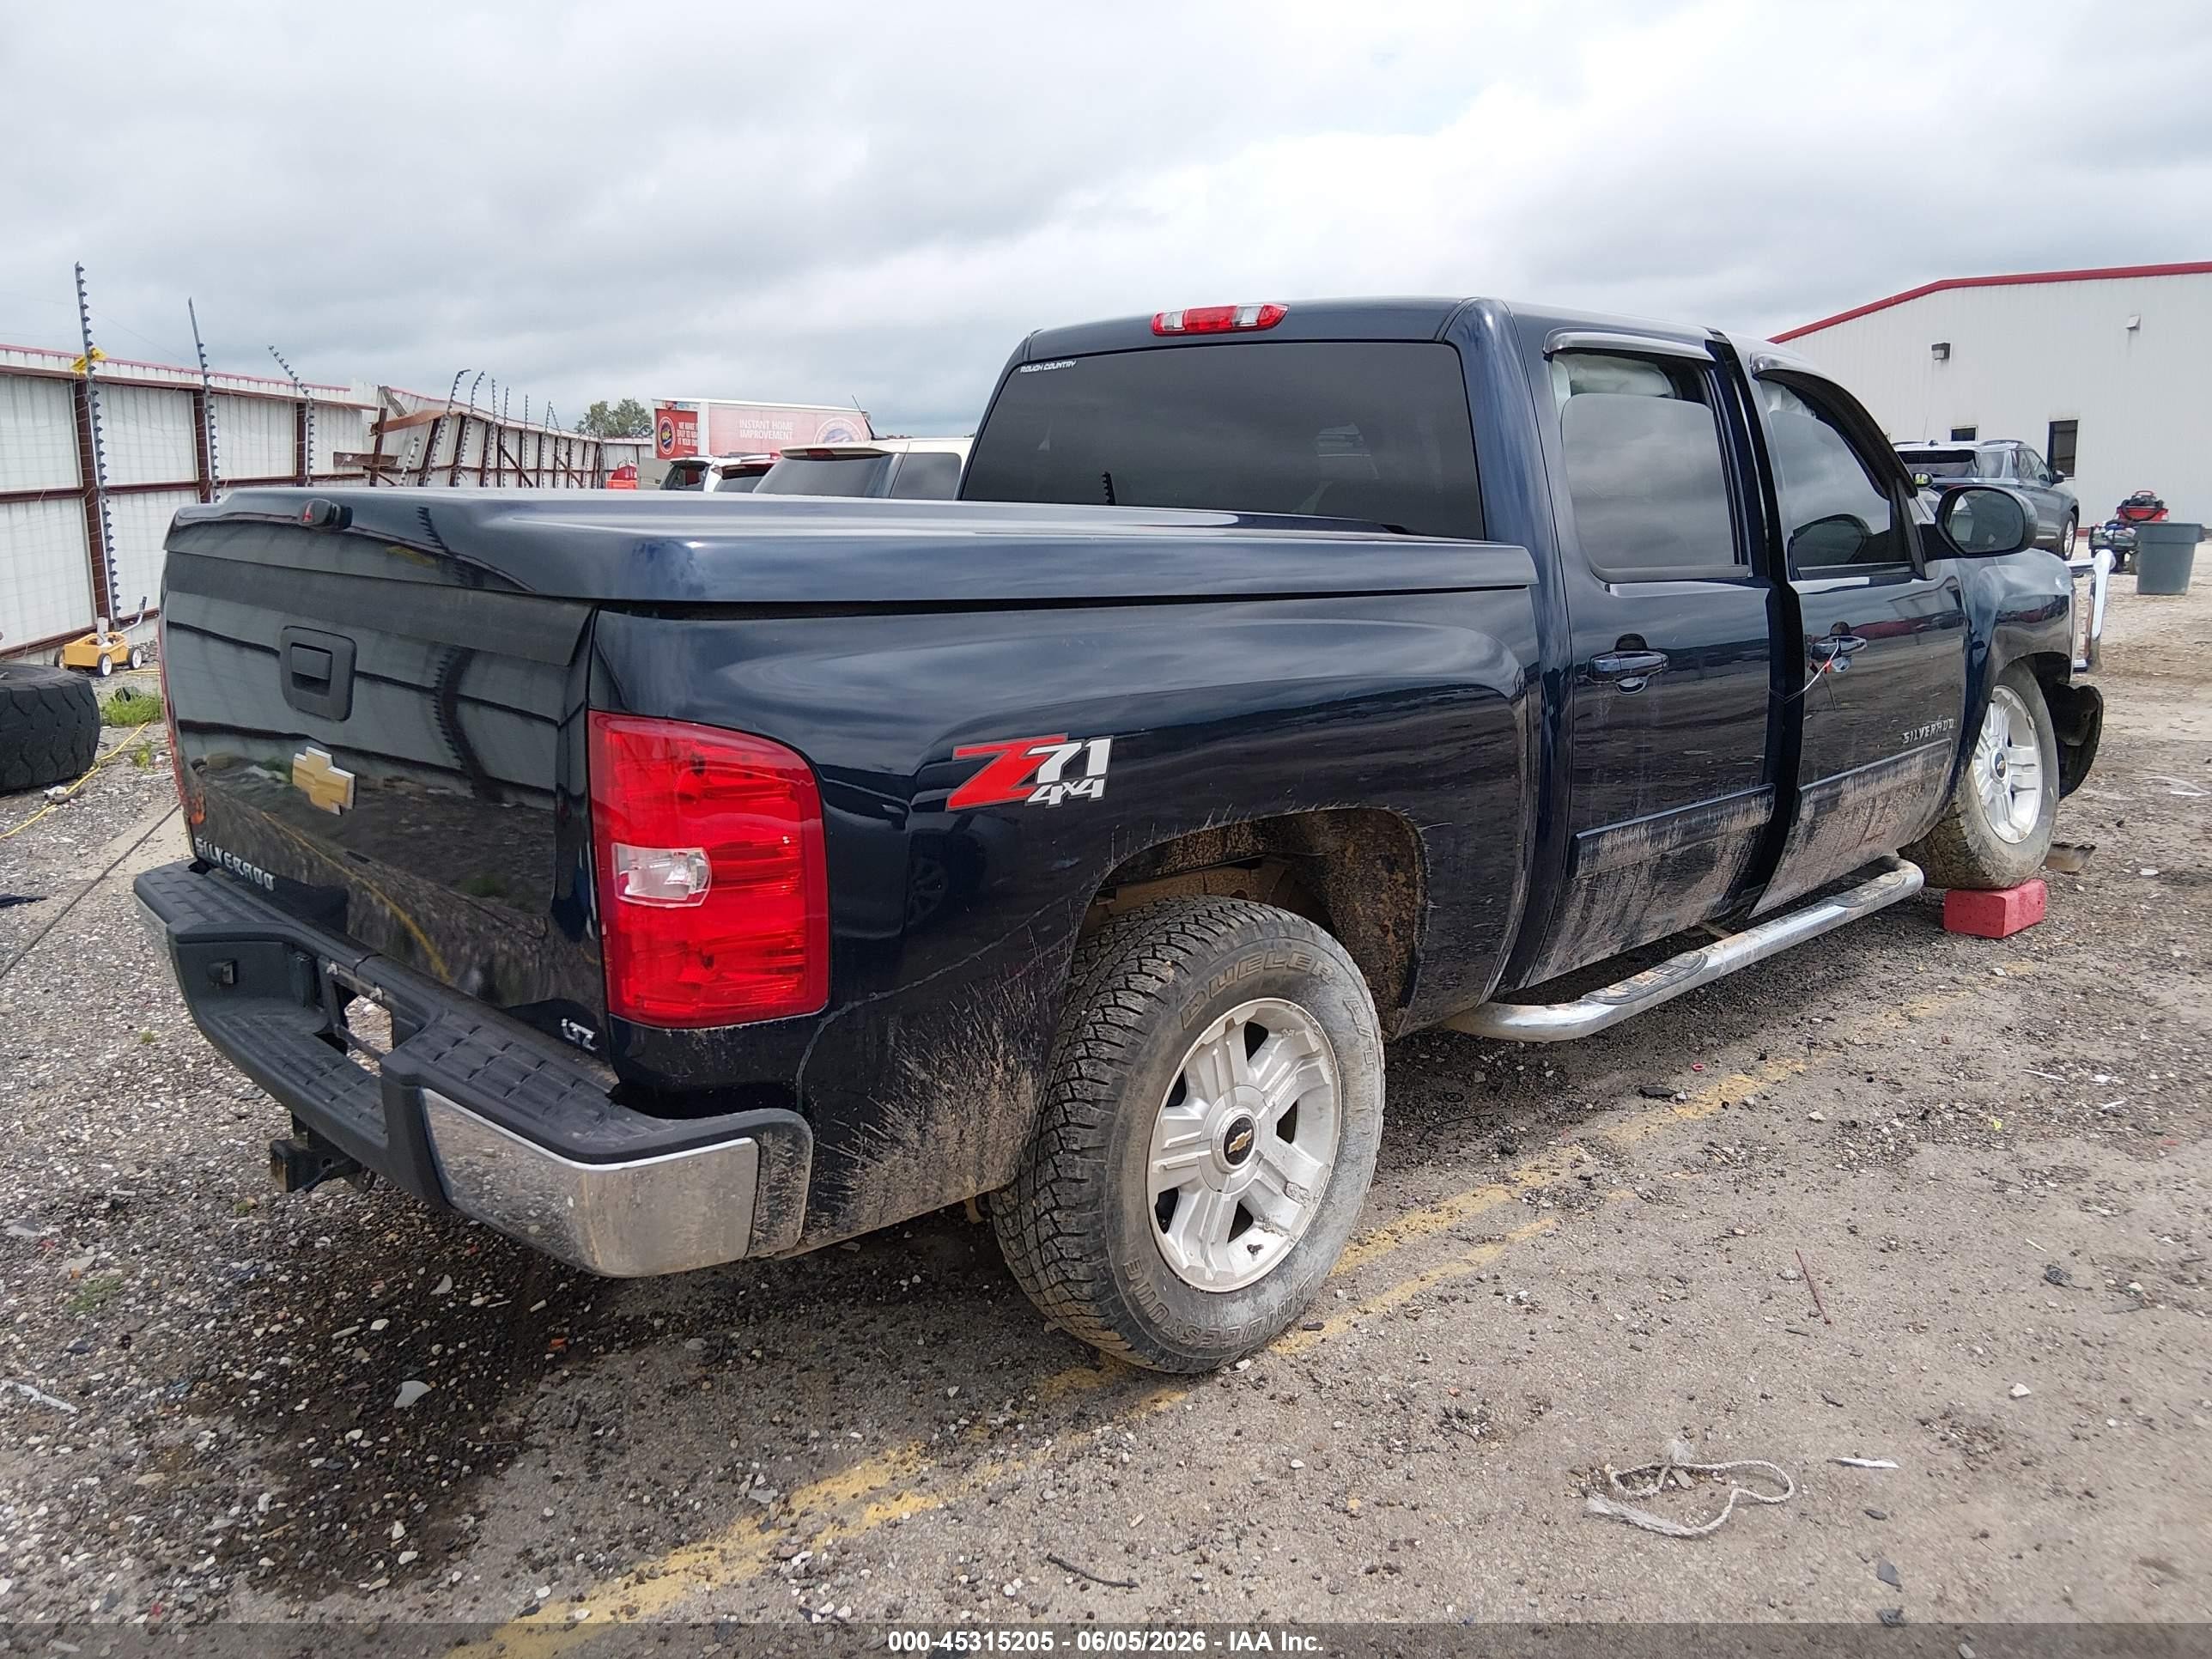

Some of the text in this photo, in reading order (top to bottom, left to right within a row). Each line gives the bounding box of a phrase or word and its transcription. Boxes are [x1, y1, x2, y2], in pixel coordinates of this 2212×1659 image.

[1020, 360, 1077, 373] ROUGH COUNTRY
[739, 419, 794, 431] INSTANT HOME
[739, 429, 793, 441] IMPROVEMENT
[1901, 718, 1954, 744] SILVERADO
[945, 732, 1114, 811] Z71
[194, 837, 276, 891] SILVERADO
[1180, 950, 1336, 1030] DUELER
